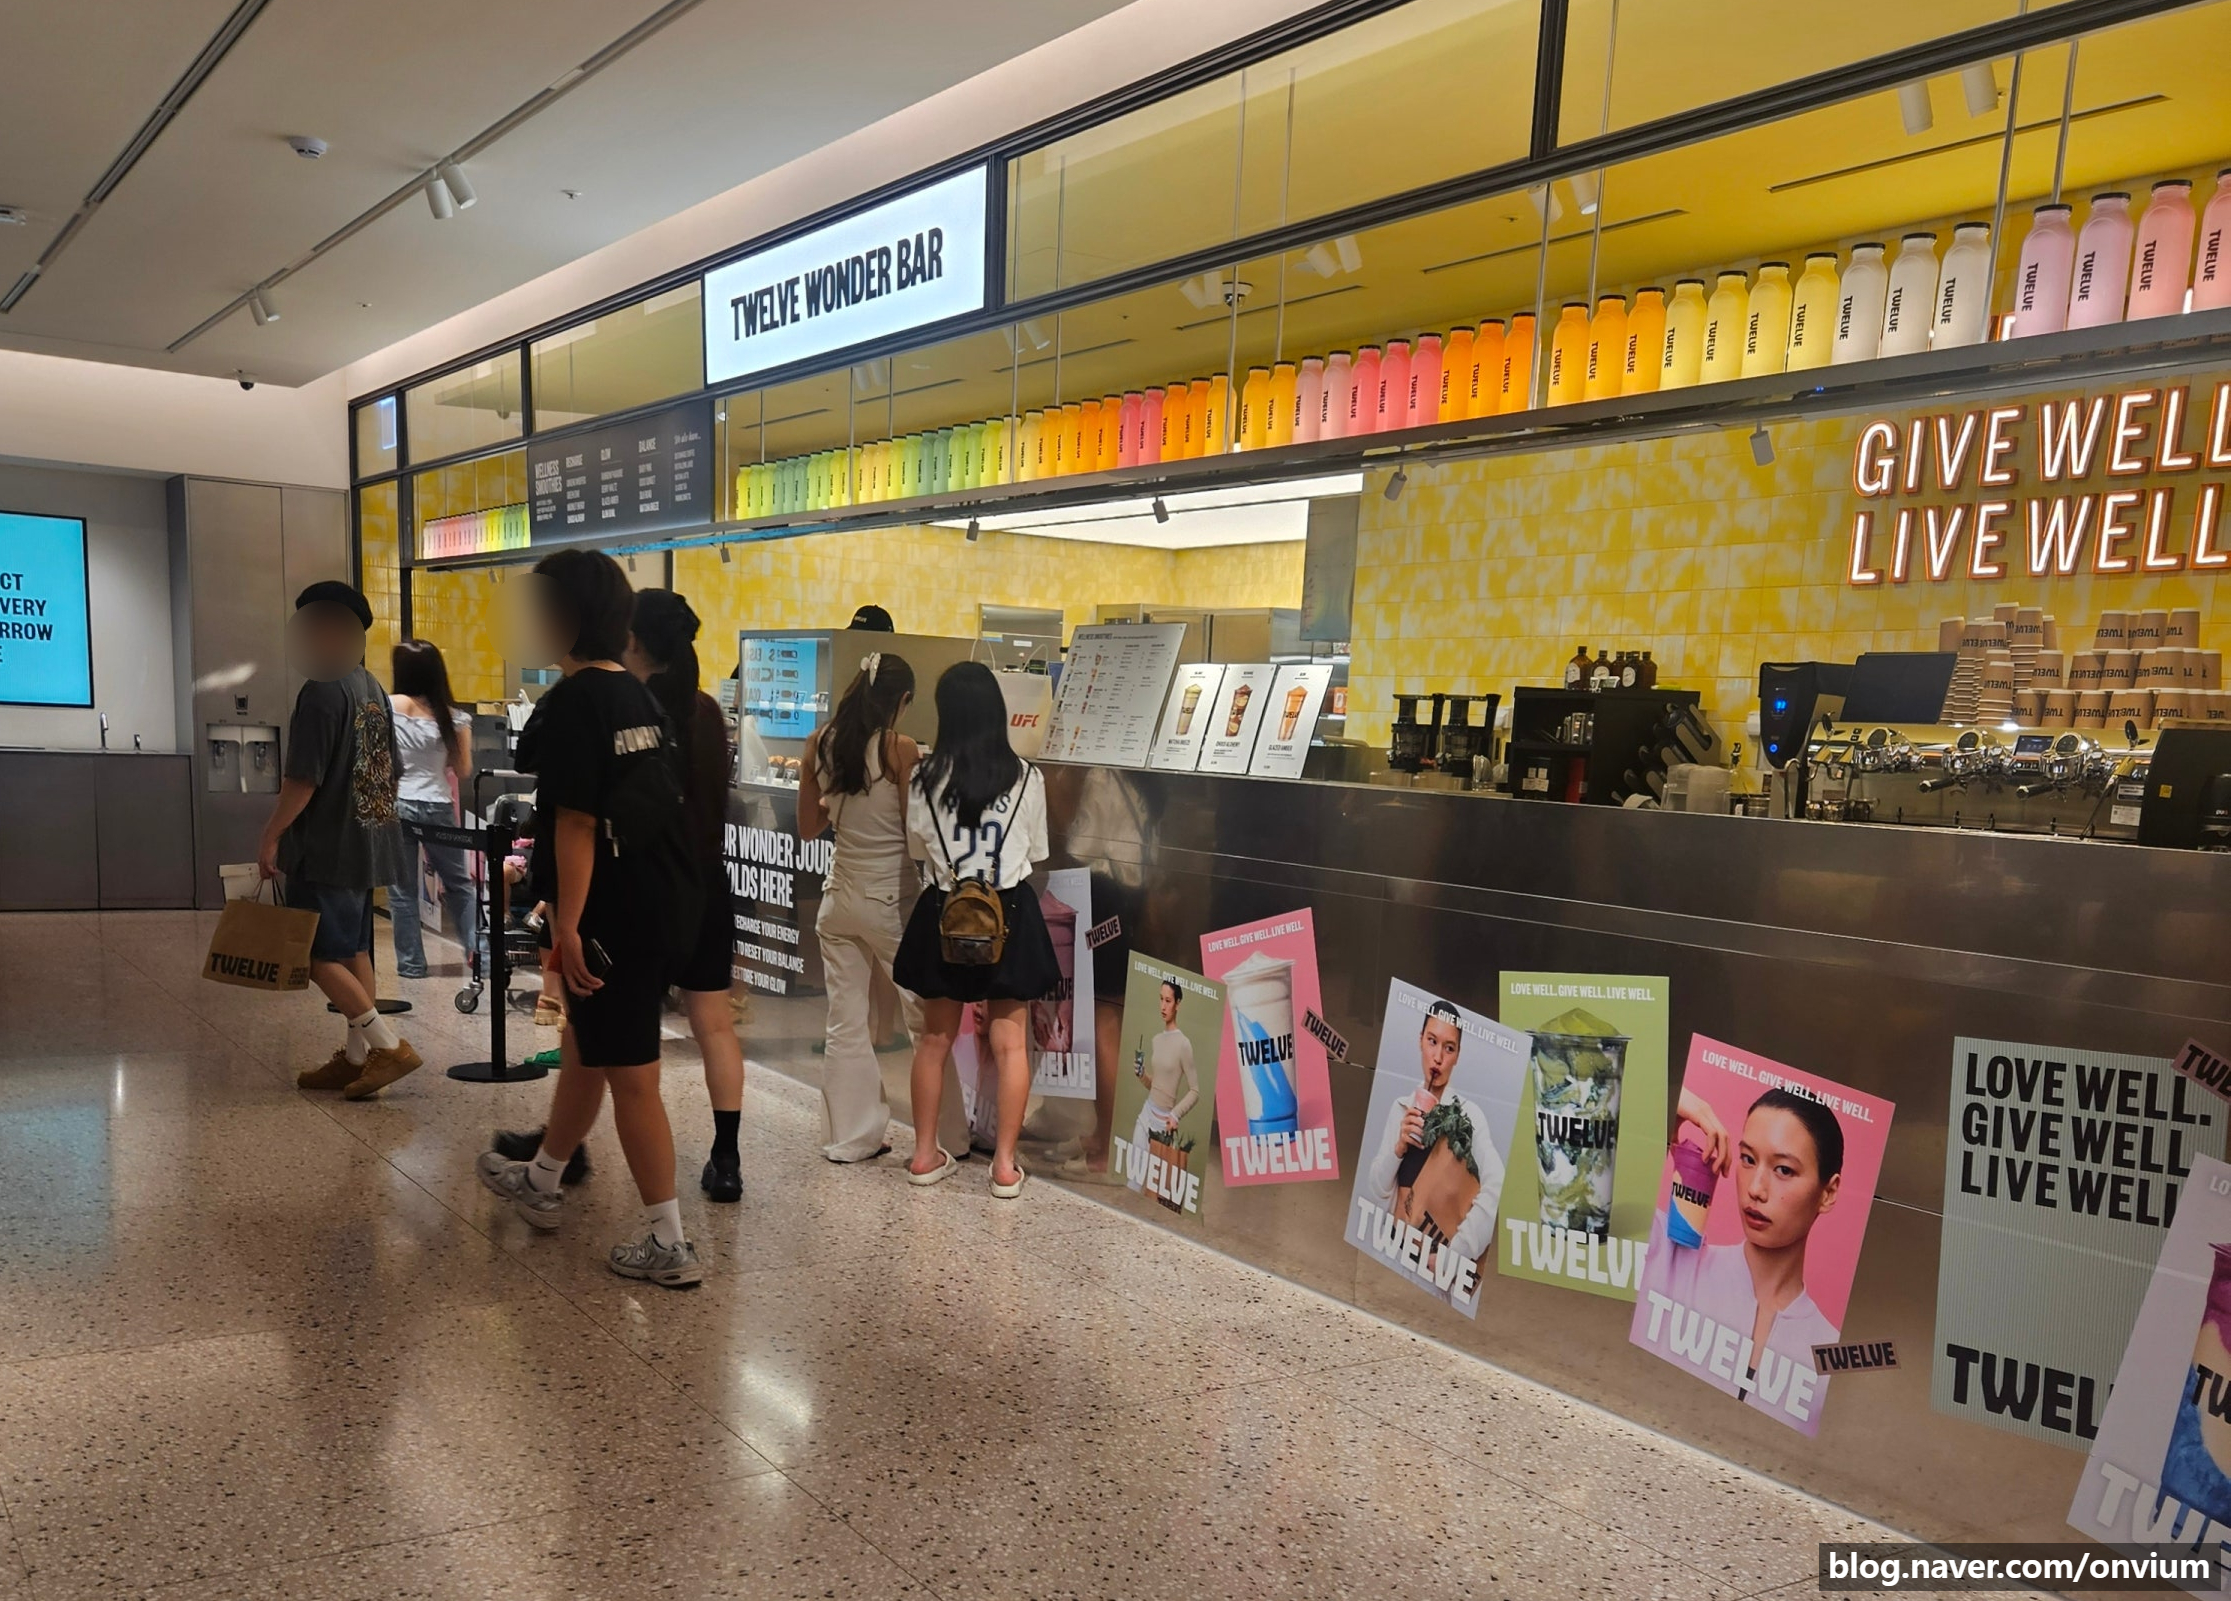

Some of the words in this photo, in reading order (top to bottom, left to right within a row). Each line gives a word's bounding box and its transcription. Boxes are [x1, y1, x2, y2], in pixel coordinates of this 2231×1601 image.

[2078, 251, 2096, 301] TWELVE
[2139, 240, 2157, 291] TWELVE
[2203, 229, 2222, 282] TWELVE
[731, 276, 800, 341] TWELVE
[805, 245, 892, 319] WONDER
[897, 227, 943, 291] BAR
[1941, 277, 1956, 324] TWELVE
[2022, 262, 2039, 311] TWELVE
[1793, 303, 1807, 347] TWELVE
[1839, 295, 1853, 340] TWELVE
[1888, 287, 1903, 333] TWELVE
[1627, 333, 1638, 374] TWELVE
[1664, 326, 1676, 368] TWELVE
[1706, 320, 1718, 361] TWELVE
[1747, 312, 1759, 354] TWELVE
[1470, 361, 1481, 399] TWELVE
[1502, 357, 1511, 393] TWELVE
[1552, 348, 1562, 386] TWELVE
[1588, 341, 1599, 380] TWELVE
[1321, 389, 1330, 423] TWELVE
[1349, 384, 1359, 419] TWELVE
[1378, 378, 1388, 414] TWELVE
[1409, 373, 1419, 410] TWELVE
[1440, 368, 1451, 405] TWELVE
[1241, 402, 1249, 435] TWELVE
[1267, 397, 1276, 431] TWELVE
[1294, 393, 1303, 427] TWELVE
[1853, 404, 2027, 497] GIVE
[2038, 381, 2231, 482] WELL
[1847, 499, 2016, 585] LIVE
[2027, 483, 2231, 577] WELL
[1010, 713, 1040, 728] UFC
[738, 825, 794, 869] WONDER
[796, 838, 835, 876] JOUR
[761, 868, 794, 909] HERE
[761, 921, 777, 939] YOUR
[777, 925, 800, 946] ENERGY
[1087, 918, 1120, 948] TWELVE
[1208, 940, 1223, 953] LOVE
[1240, 933, 1254, 945] GIVE
[1271, 924, 1286, 937] LIVE
[211, 952, 280, 983] TWELVE
[745, 942, 761, 961] RESET
[762, 947, 778, 965] YOUR
[778, 951, 805, 974] BALANCE
[1134, 961, 1148, 974] LOVE
[1162, 971, 1175, 984] GIVE
[1191, 982, 1203, 994] LIVE
[754, 971, 770, 990] YOUR
[770, 976, 787, 995] GLOW
[1510, 982, 1532, 996] LOVE
[1532, 983, 1557, 997] WELL.
[1558, 984, 1578, 998] GIVE
[1579, 985, 1606, 999] WELL.
[1607, 986, 1628, 1000] LIVE
[1627, 987, 1655, 1001] WELL.
[1304, 1011, 1347, 1058] TWELVE
[1398, 991, 1416, 1008] LOVE
[1438, 1009, 1456, 1026] GIVE
[1478, 1027, 1495, 1044] LIVE
[1495, 1035, 1518, 1054] WELL.
[1238, 1032, 1294, 1067] TWELVE
[1702, 1050, 1728, 1070] LOVE
[1728, 1058, 1757, 1081] WELL.
[1758, 1070, 1782, 1090] GIVE
[1783, 1079, 1814, 1102] WELL.
[1815, 1090, 1841, 1111] LIVE
[1842, 1099, 1873, 1123] WELL.
[1966, 1052, 2067, 1107] LOVE
[2075, 1064, 2211, 1127] WELL.
[1537, 1111, 1618, 1151] TWELVE
[1962, 1102, 2063, 1158] GIVE
[2072, 1115, 2190, 1178] WELL
[1225, 1128, 1332, 1178] TWELVE
[1113, 1136, 1199, 1214] TWELVE
[1672, 1182, 1711, 1209] TWELVE
[1961, 1151, 2059, 1209] LIVE
[1357, 1195, 1477, 1305] TWELVE
[1646, 1289, 1818, 1422] TWELVE
[1815, 1342, 1897, 1372] TWELVE
[1946, 1343, 2113, 1440] TWEL
